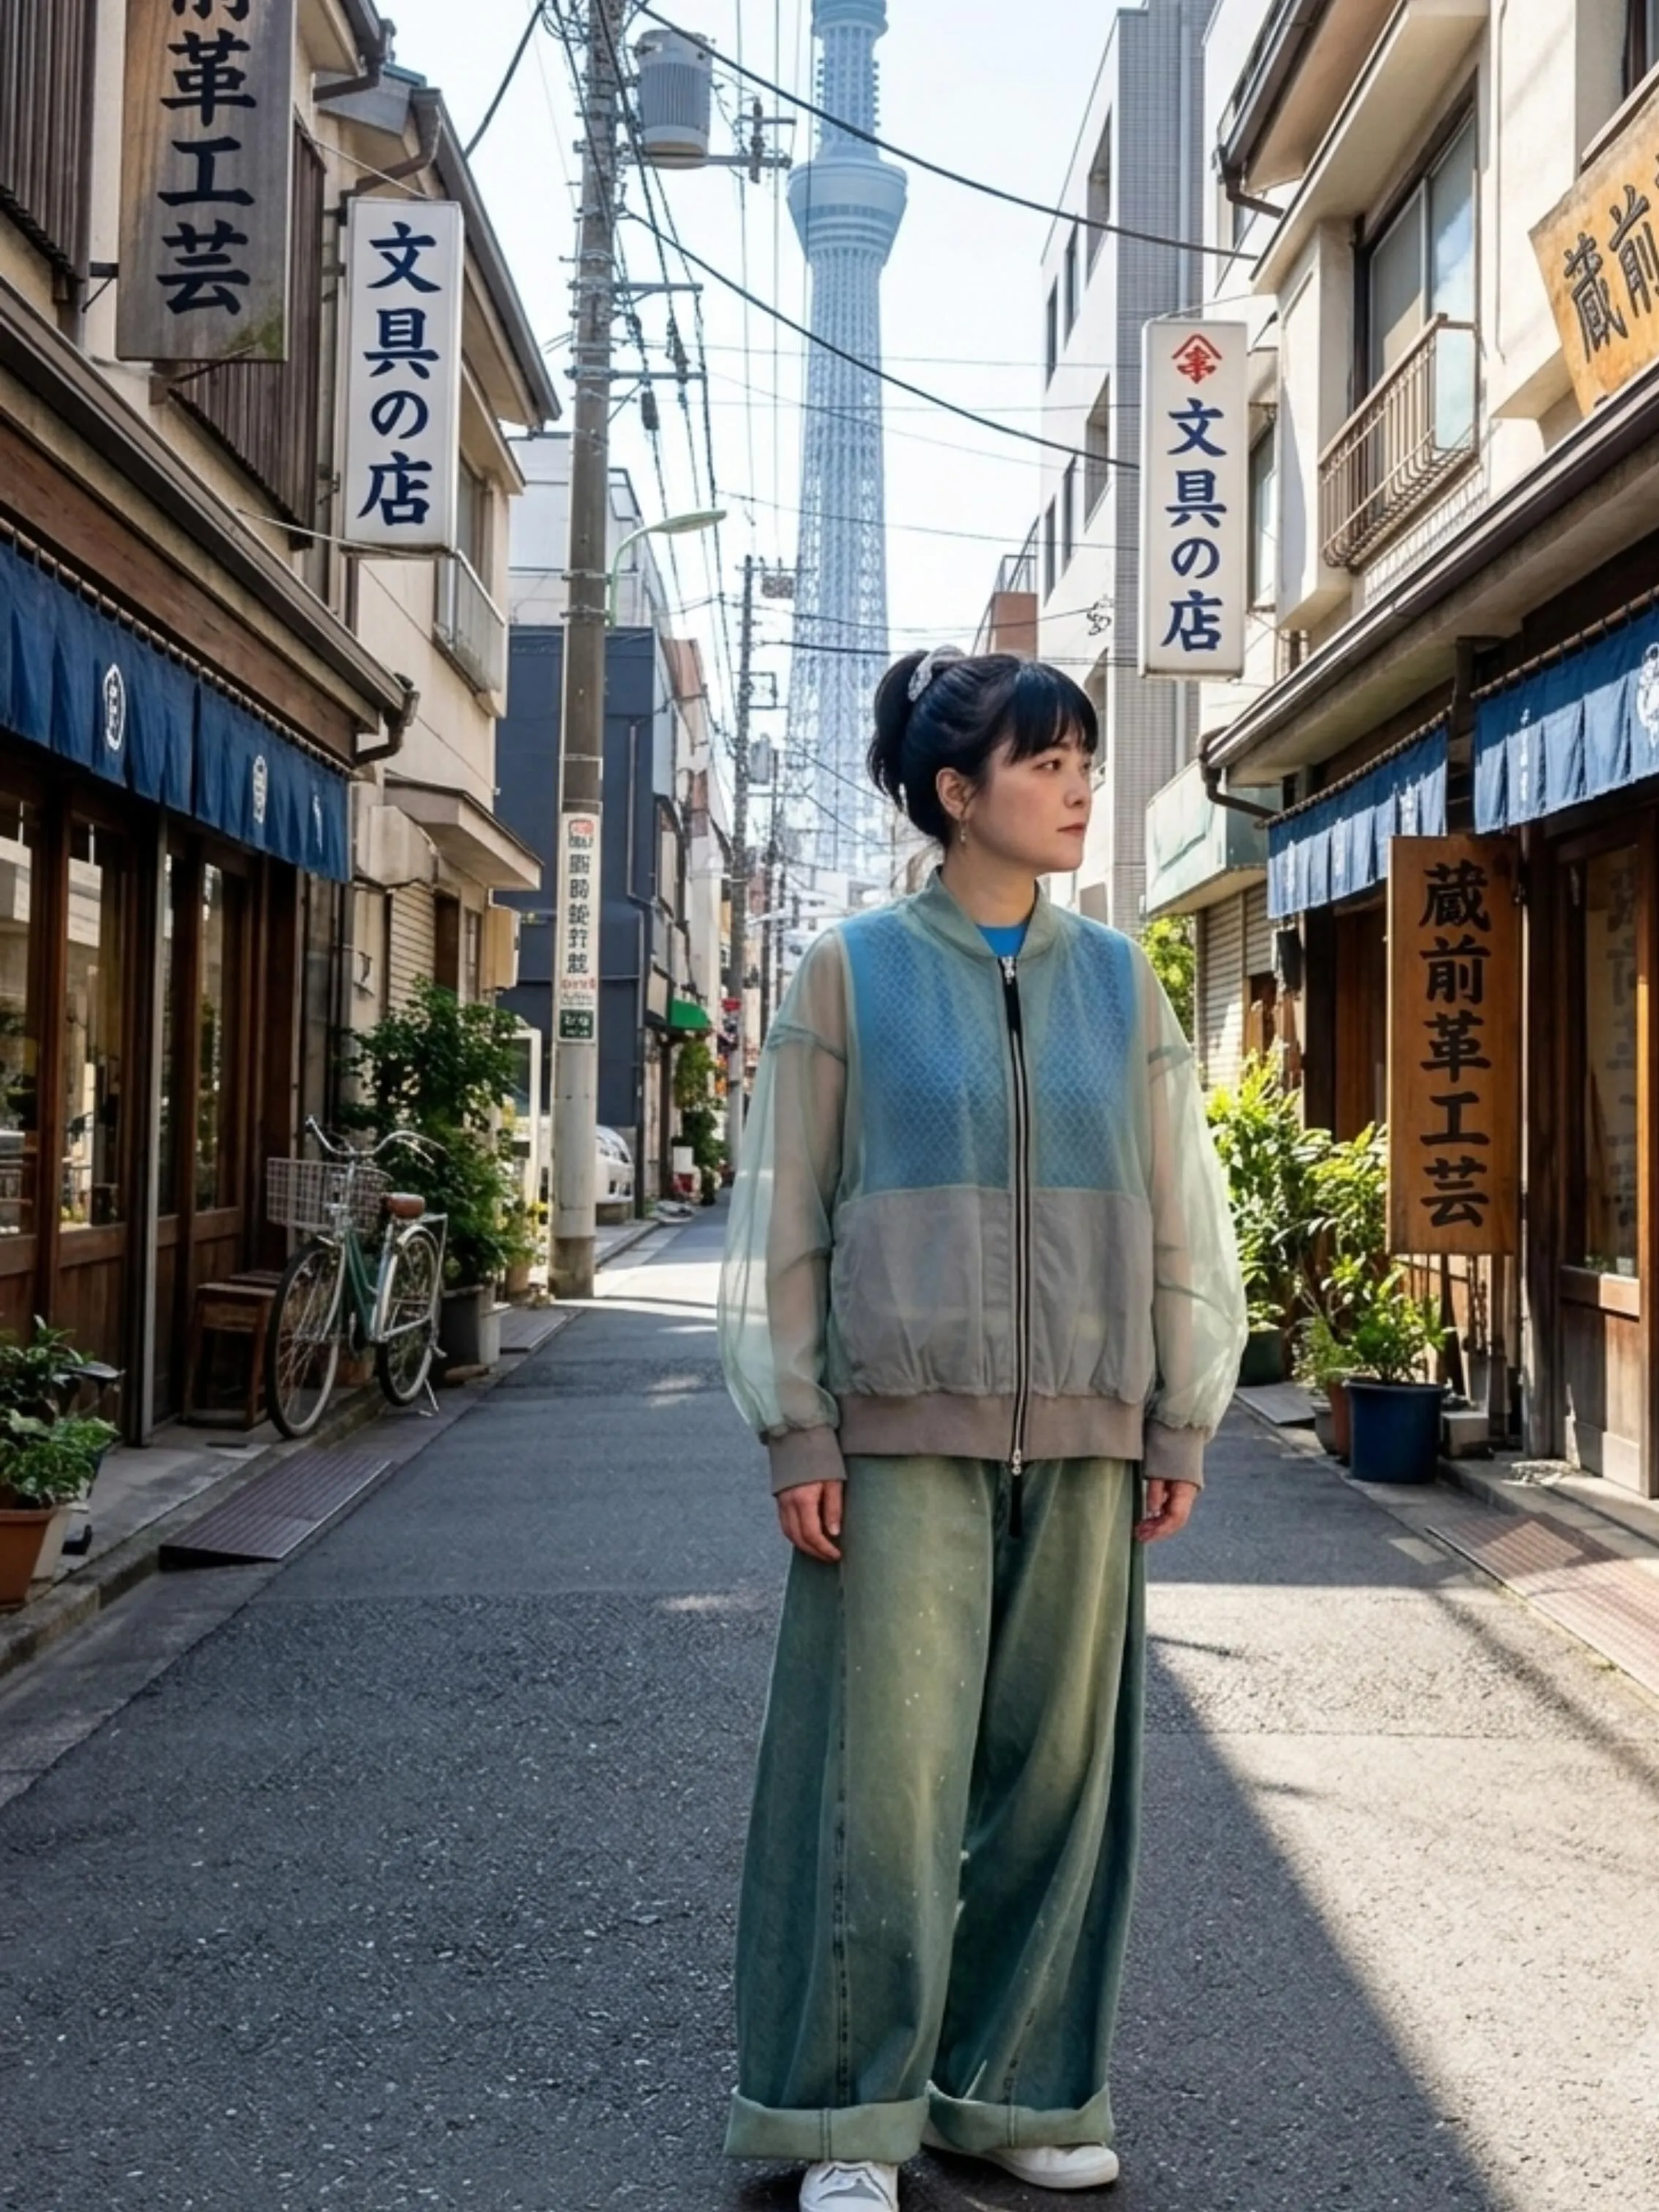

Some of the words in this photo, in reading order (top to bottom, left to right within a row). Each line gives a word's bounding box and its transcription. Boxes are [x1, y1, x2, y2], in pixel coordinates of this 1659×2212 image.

[156, 0, 257, 316] 革工芸
[1563, 150, 1659, 364] 蔵前
[358, 221, 442, 527] 文具の店
[1161, 397, 1227, 652] 文具の店
[1418, 861, 1492, 1229] 蔵前革工芸
